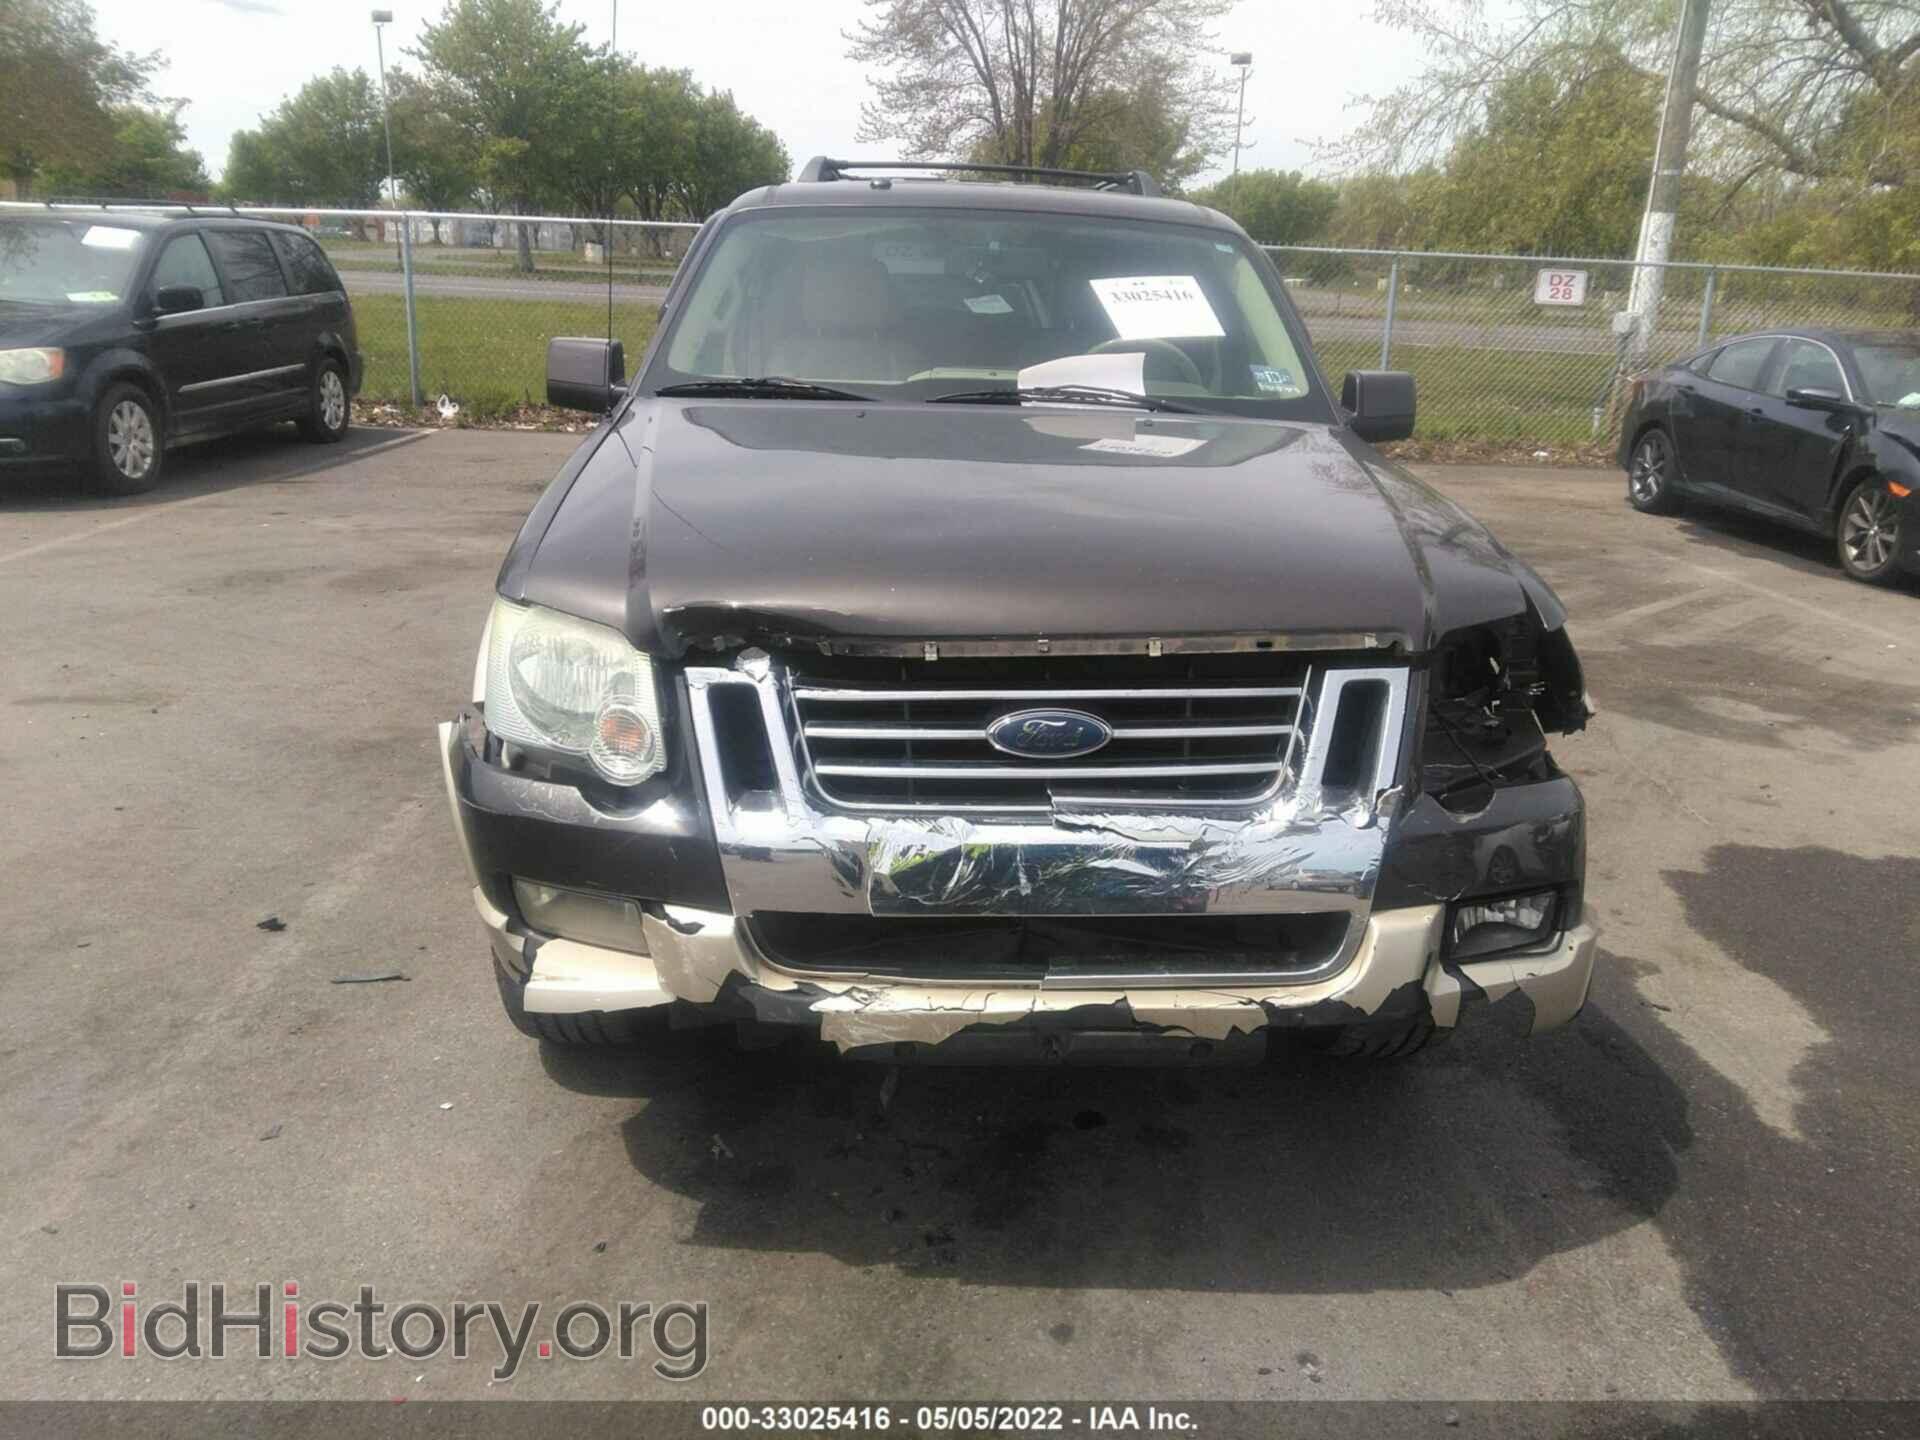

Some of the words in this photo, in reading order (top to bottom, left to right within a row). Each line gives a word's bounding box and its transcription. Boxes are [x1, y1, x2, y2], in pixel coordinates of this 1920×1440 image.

[1550, 274, 1577, 287] DZ
[1110, 289, 1195, 304] 33025416
[1549, 287, 1573, 300] 28
[1017, 719, 1084, 746] Ford
